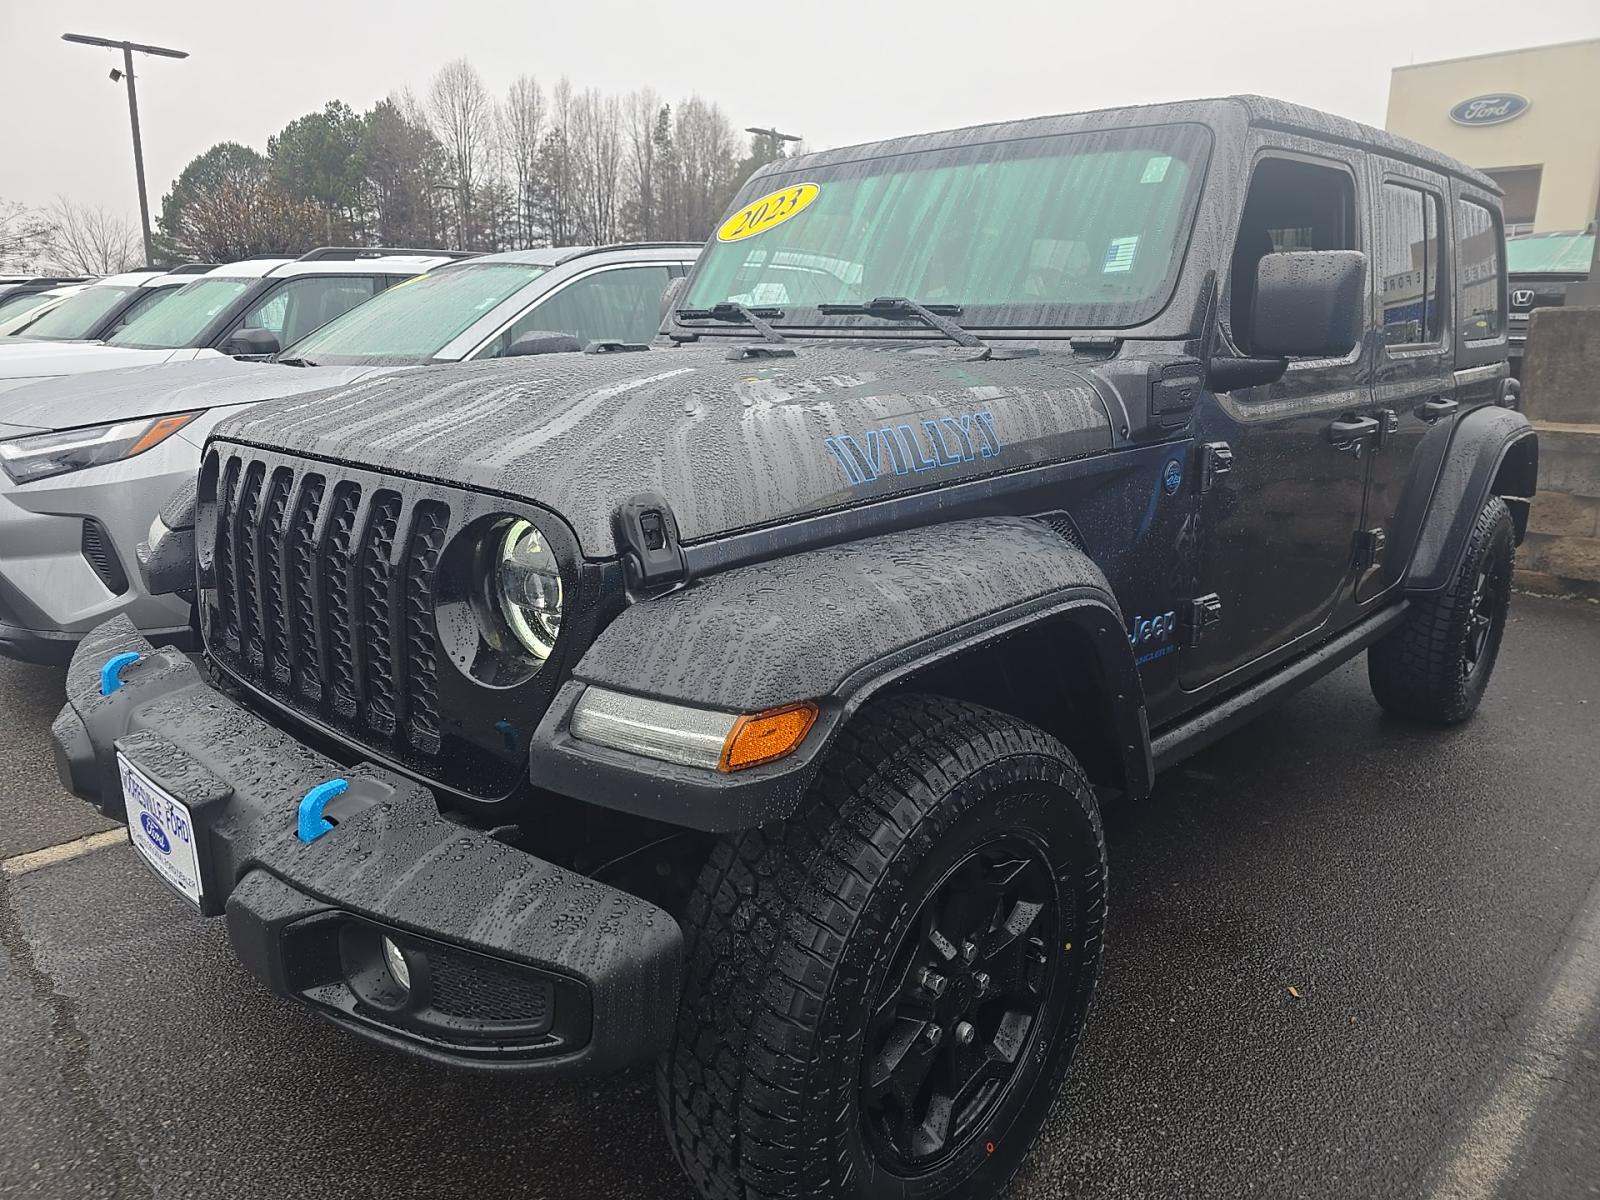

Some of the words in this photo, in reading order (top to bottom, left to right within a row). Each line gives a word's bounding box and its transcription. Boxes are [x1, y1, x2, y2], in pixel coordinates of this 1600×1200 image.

[1464, 98, 1512, 119] Ford
[730, 188, 803, 237] 2023
[825, 411, 1002, 485] WILLYS
[1127, 611, 1176, 644] Jeep
[145, 816, 166, 849] Ford
[165, 811, 189, 844] FORD
